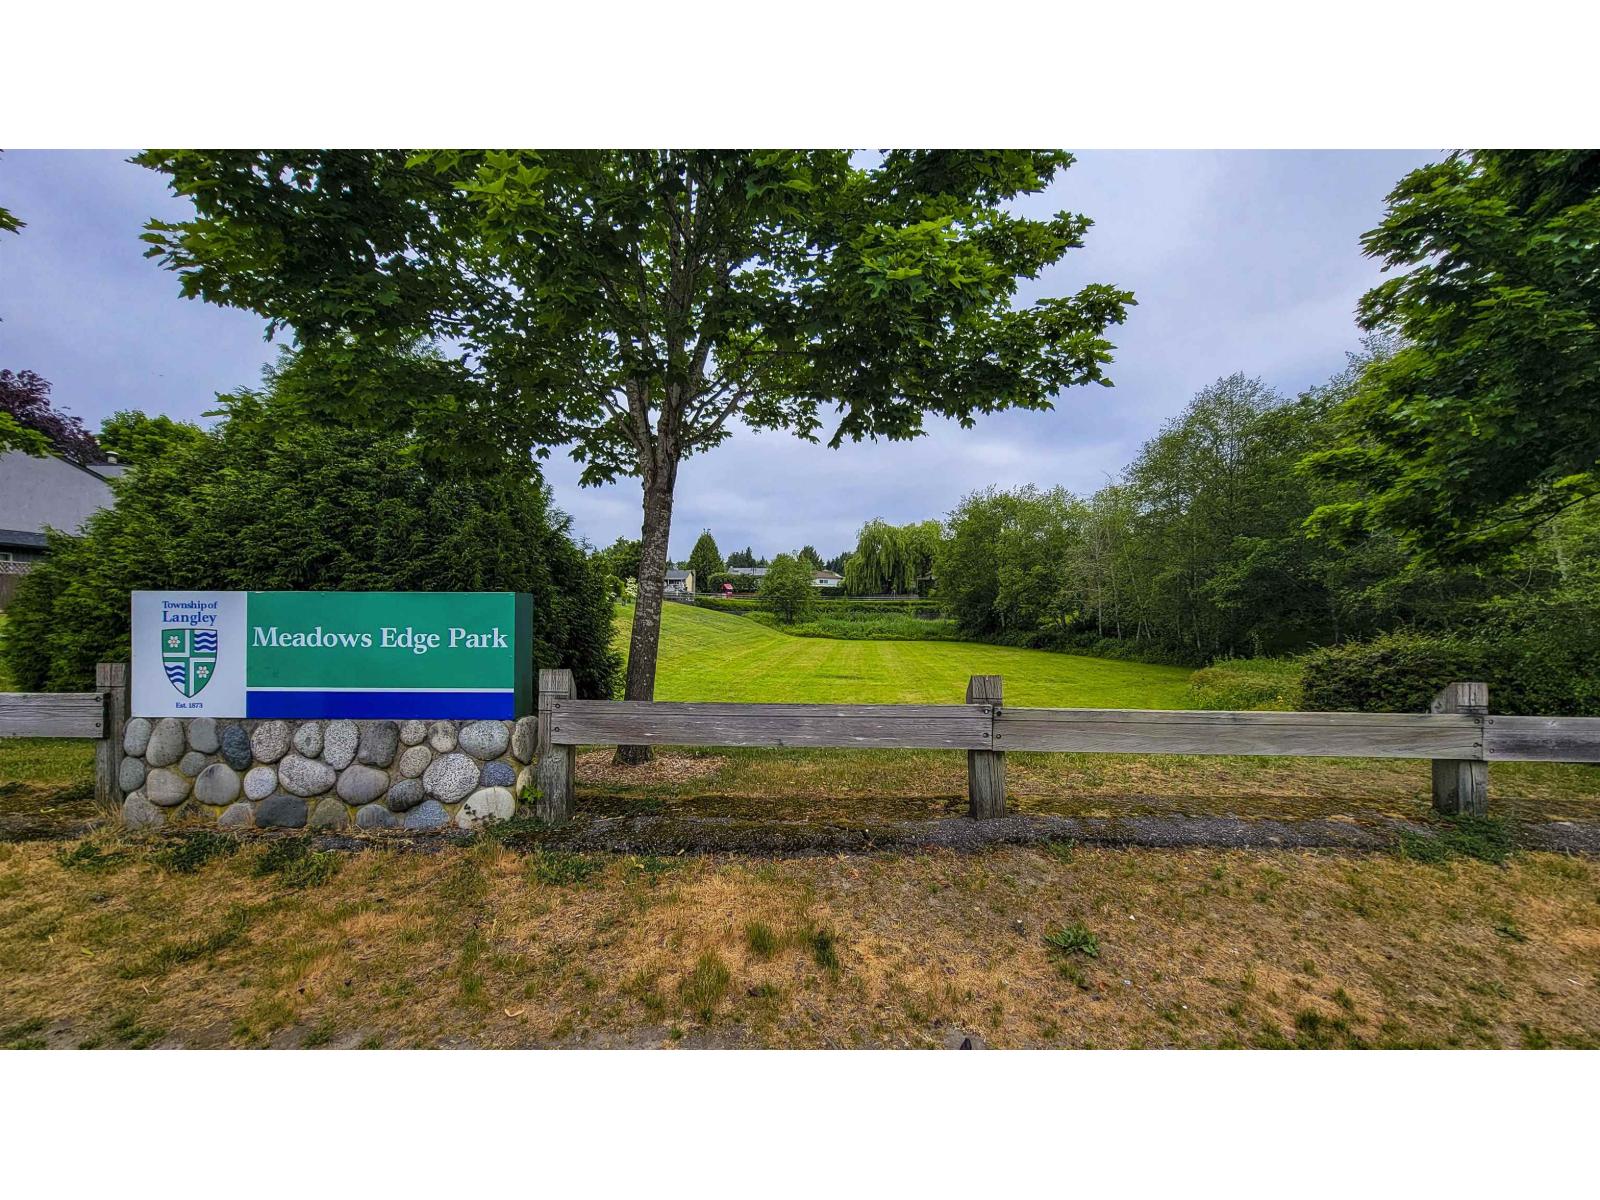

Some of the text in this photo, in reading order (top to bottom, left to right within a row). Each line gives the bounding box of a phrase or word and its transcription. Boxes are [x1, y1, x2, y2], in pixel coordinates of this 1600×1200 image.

[162, 601, 218, 611] Township of
[162, 611, 217, 626] Langley
[252, 626, 508, 654] Meadows Edge Park
